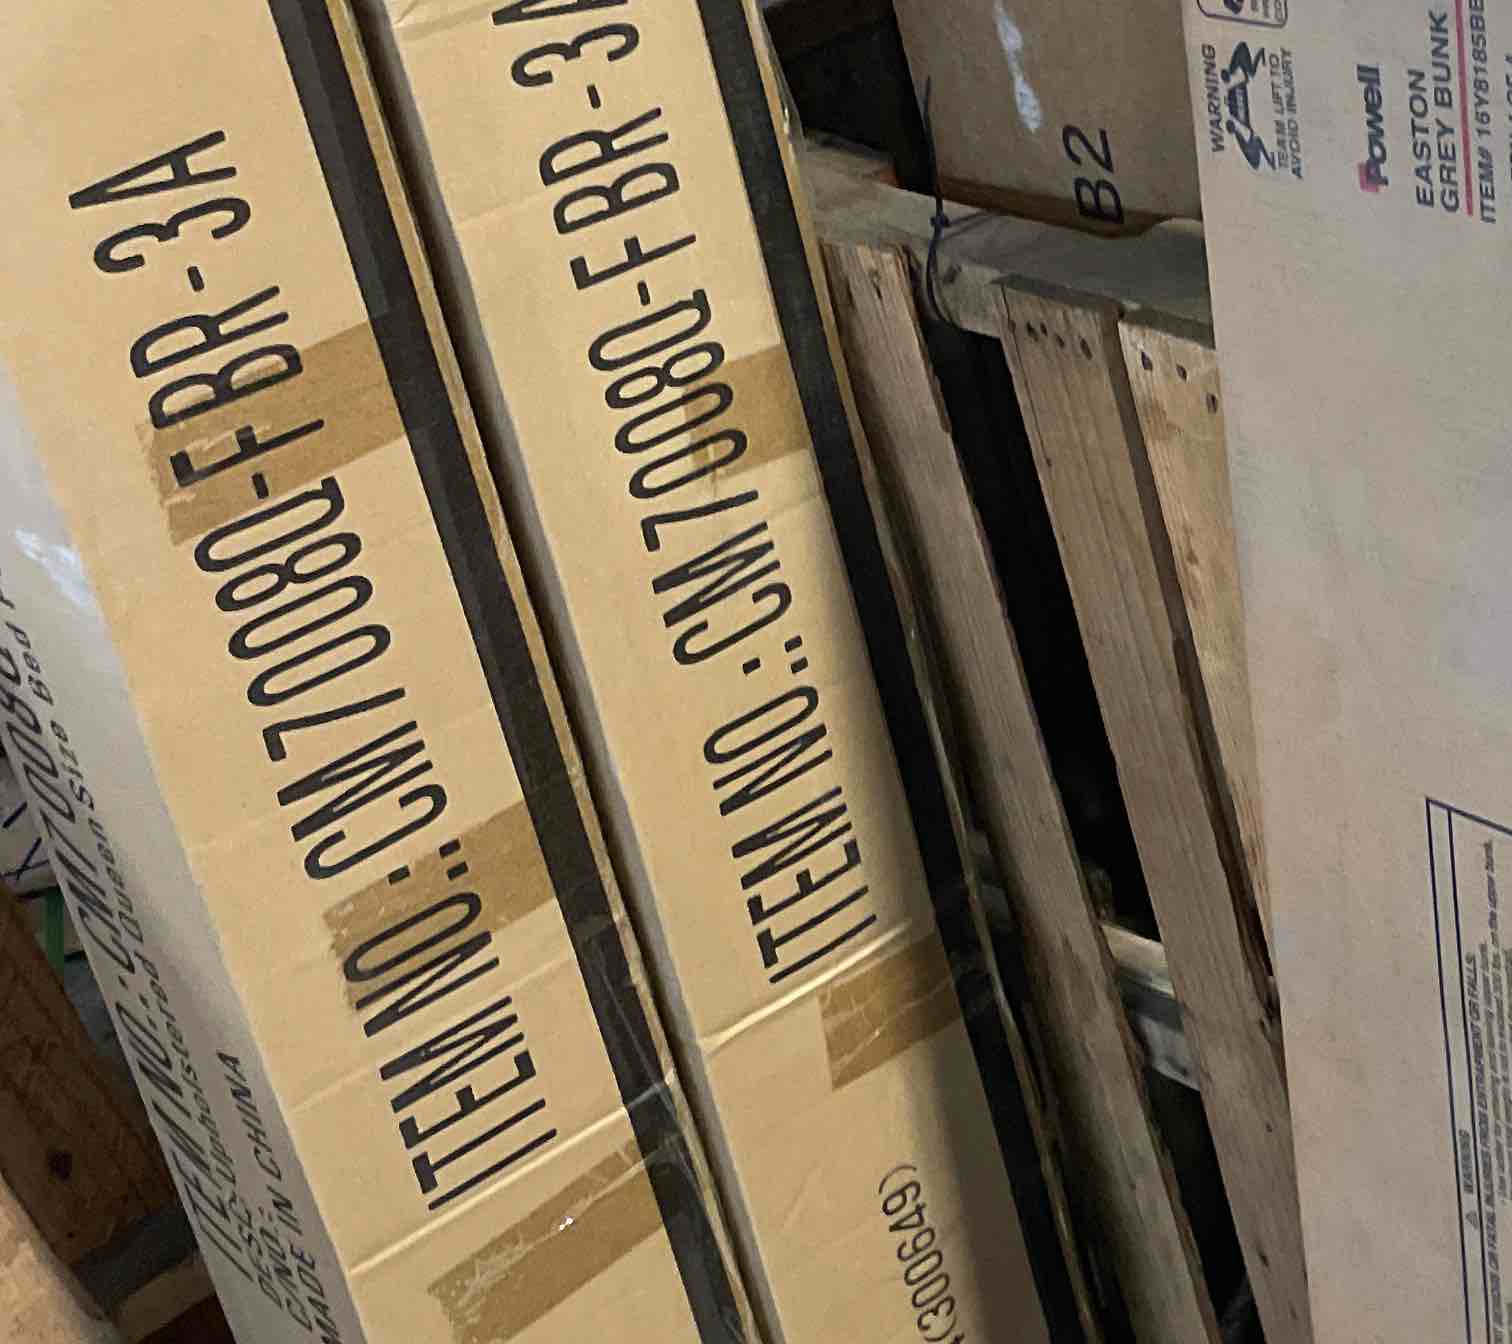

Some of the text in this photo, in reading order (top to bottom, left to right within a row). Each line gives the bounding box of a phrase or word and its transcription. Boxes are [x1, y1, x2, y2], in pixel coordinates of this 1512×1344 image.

[1201, 43, 1225, 152] WARNING
[1267, 53, 1288, 167] TEAM LIFT TO
[1279, 47, 1302, 178] AVOID INJURY
[1428, 10, 1452, 108] BUNK
[1062, 123, 1125, 225] B2
[1358, 64, 1389, 193] Powell
[1407, 68, 1433, 207] EASTON
[1435, 117, 1459, 212] GREY
[1477, 150, 1495, 223] ITEM#
[6, 621, 54, 707] Bed
[703, 636, 832, 816] NO.:
[344, 839, 499, 1037] NO.:
[732, 786, 877, 983] ITEM
[217, 1049, 283, 1182] CHINA
[380, 996, 556, 1210] ITEM
[155, 1106, 255, 1283] ITEM
[272, 1183, 305, 1237] IN
